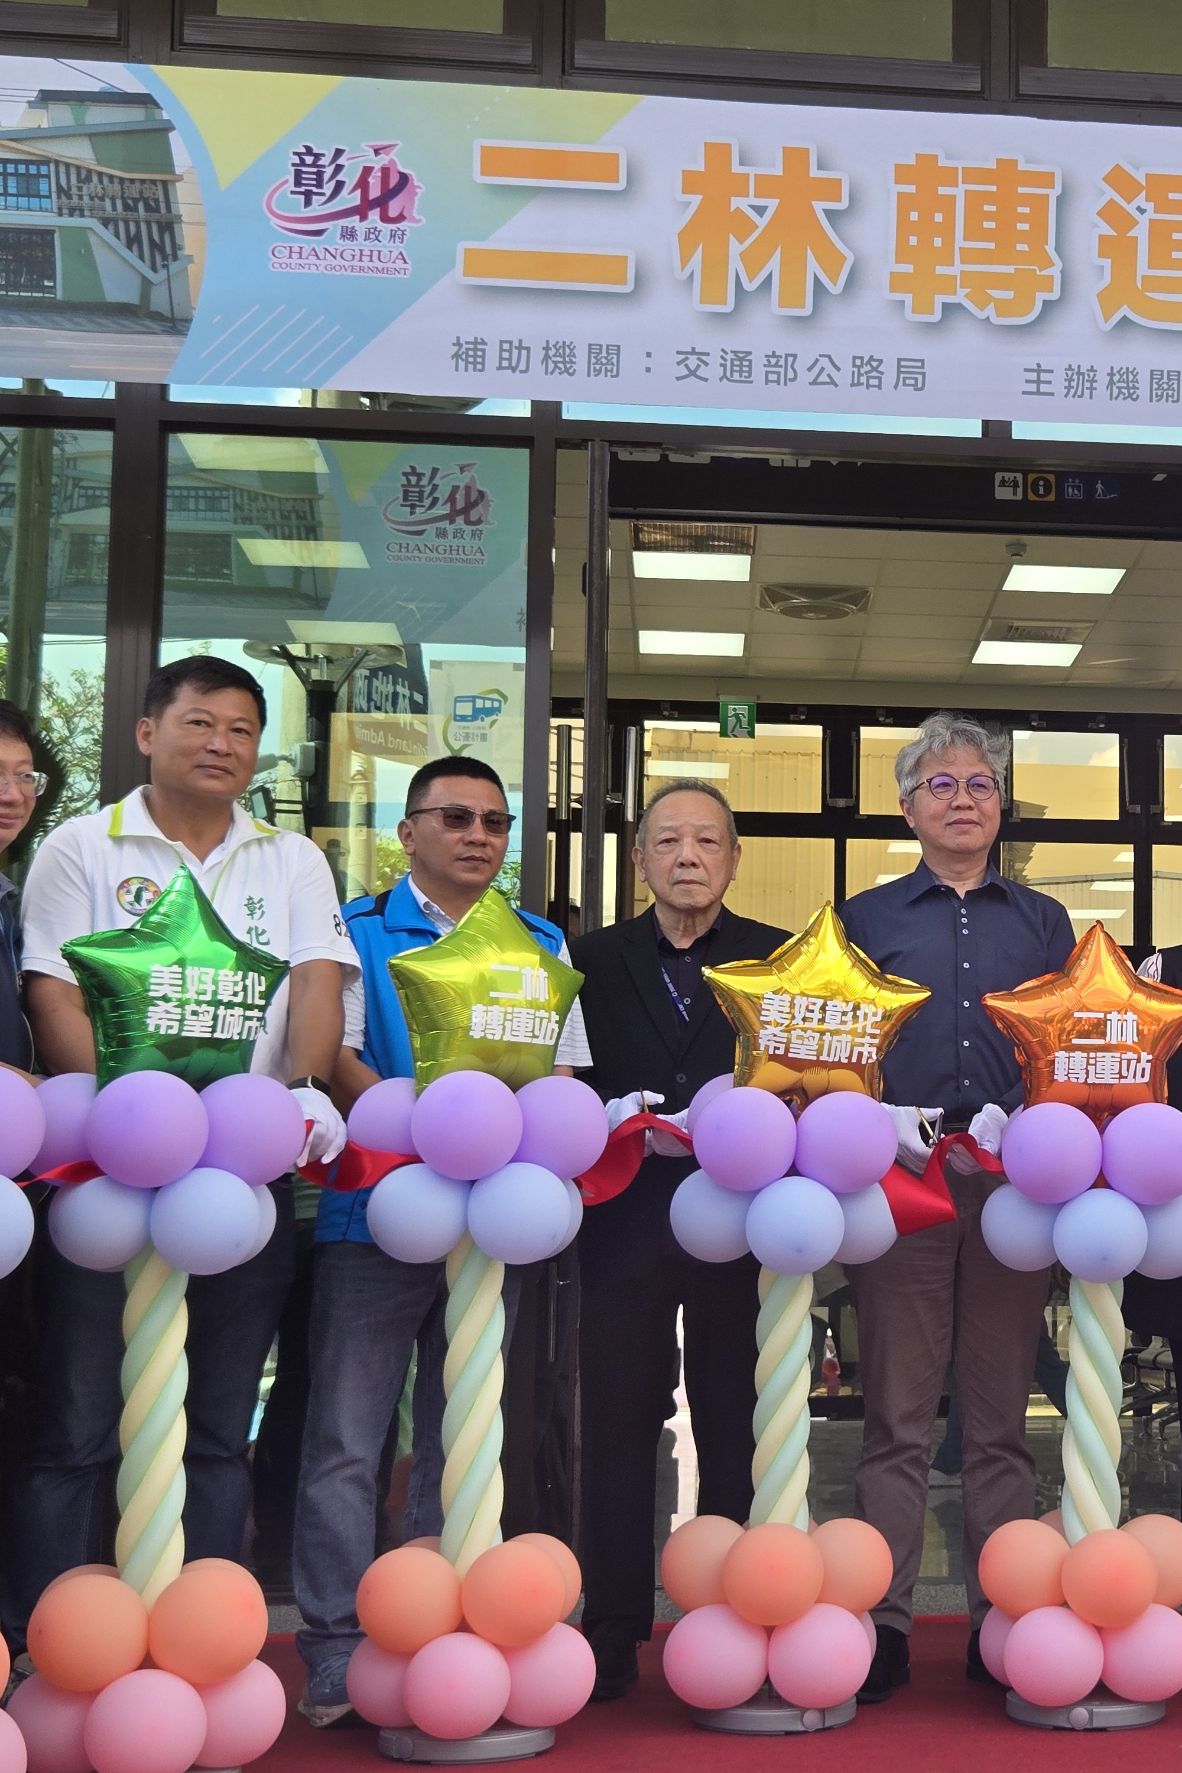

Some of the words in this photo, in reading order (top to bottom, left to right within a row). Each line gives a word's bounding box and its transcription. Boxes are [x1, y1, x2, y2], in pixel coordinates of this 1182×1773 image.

[289, 144, 408, 225] 彰化
[339, 224, 408, 244] 縣政府
[271, 244, 409, 265] CHANGHUA
[271, 261, 322, 272] COUNTY
[324, 263, 409, 276] GOVERNMENT
[450, 335, 929, 394] 補助機關：交通部公路局
[399, 464, 485, 527] 彰化
[386, 541, 486, 557] CHANGHUA
[424, 555, 486, 566] GOVERNMENT
[148, 964, 266, 1005] 美好彰化
[489, 964, 550, 1003] 二林
[146, 1000, 267, 1041] 希望城市
[469, 1005, 559, 1046] 轉運站
[758, 992, 882, 1033] 美好彰化
[1071, 1010, 1140, 1047] 二林
[757, 1026, 879, 1065] 希望城市
[1052, 1050, 1152, 1085] 轉運站
